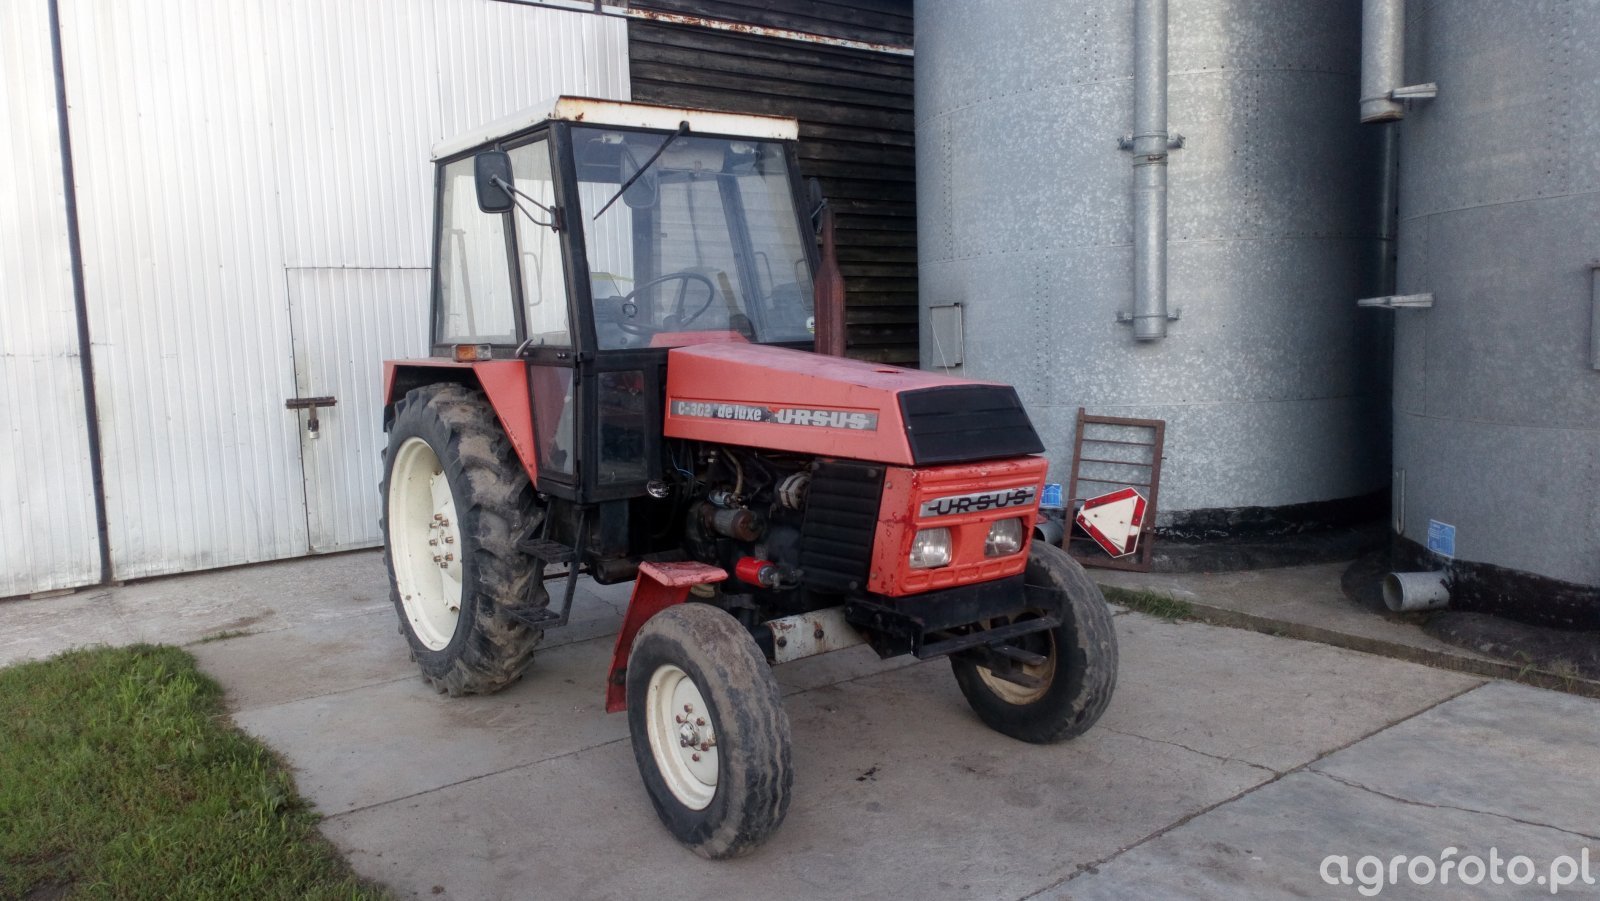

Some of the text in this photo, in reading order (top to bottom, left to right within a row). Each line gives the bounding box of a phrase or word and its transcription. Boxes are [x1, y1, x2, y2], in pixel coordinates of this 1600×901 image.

[717, 404, 733, 419] de
[734, 404, 762, 421] luxe
[774, 408, 870, 430] URSUS
[928, 489, 1034, 515] URSUS
